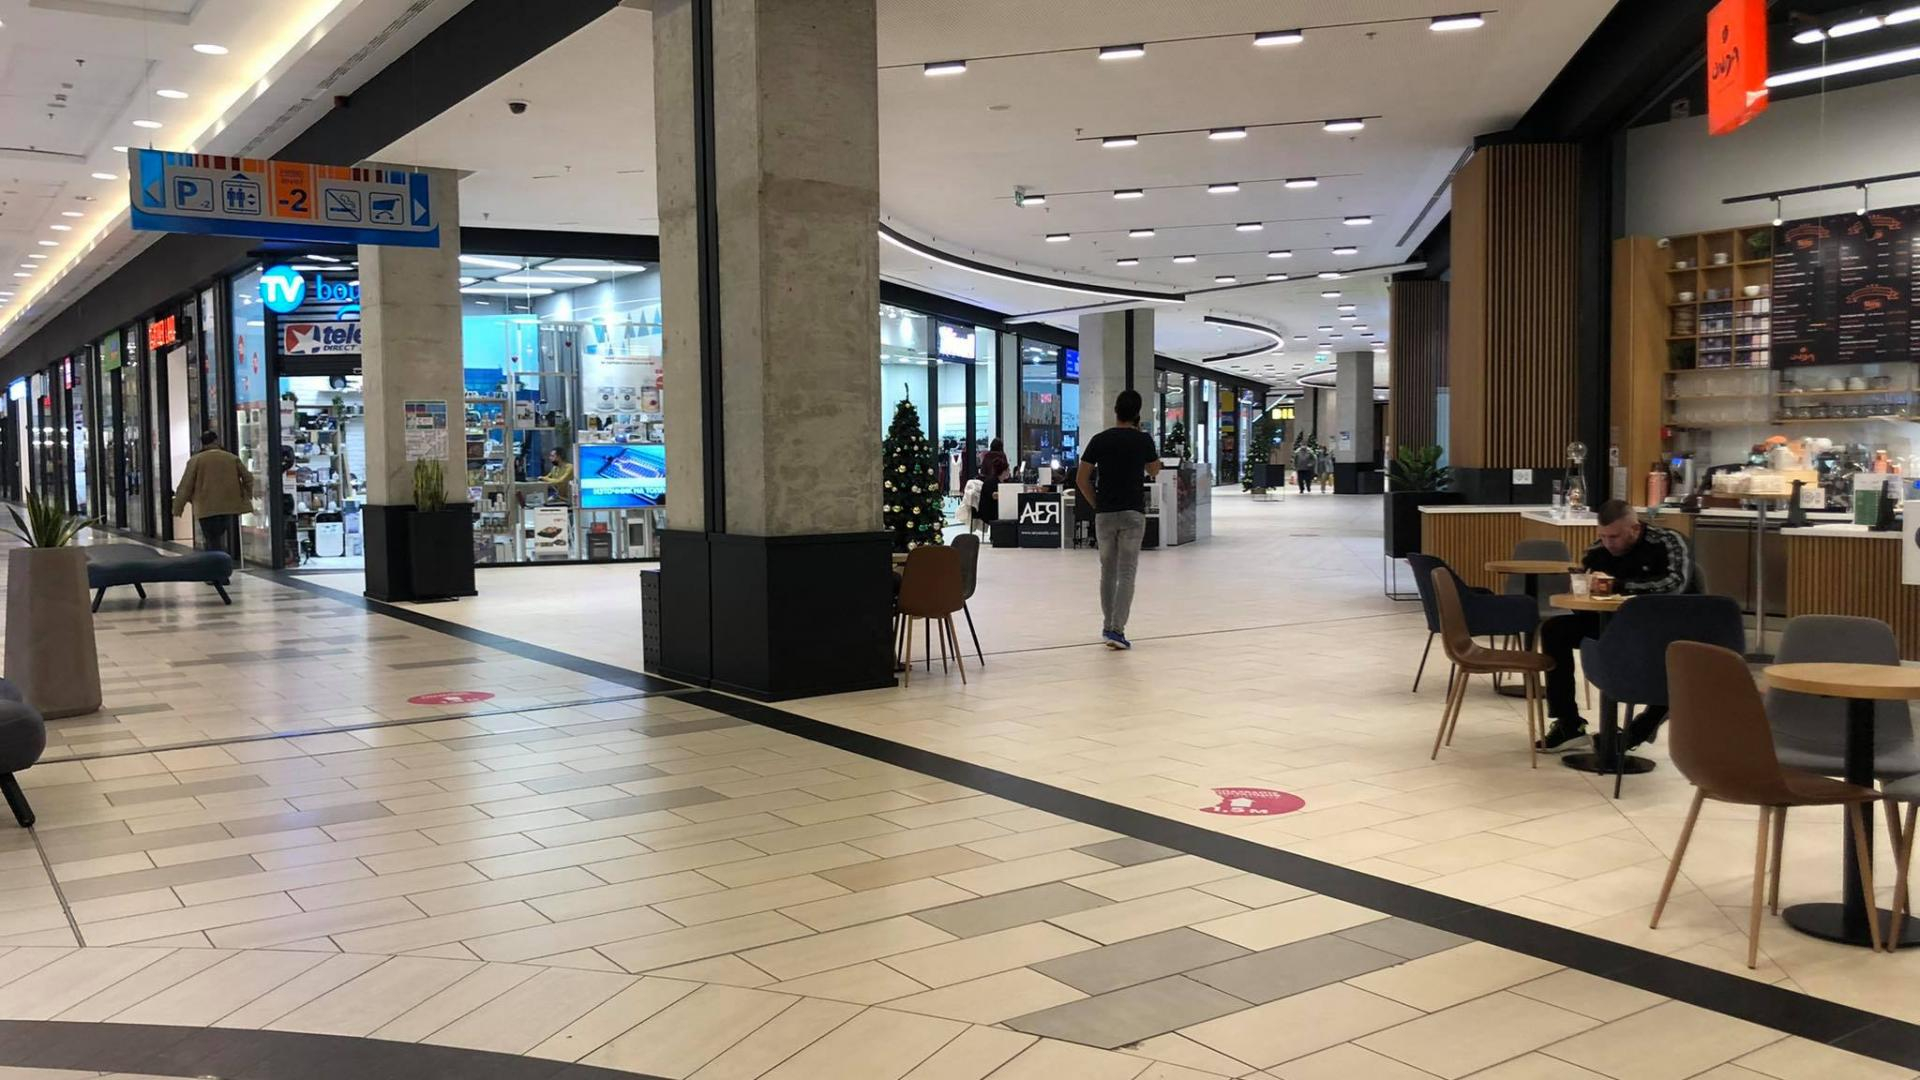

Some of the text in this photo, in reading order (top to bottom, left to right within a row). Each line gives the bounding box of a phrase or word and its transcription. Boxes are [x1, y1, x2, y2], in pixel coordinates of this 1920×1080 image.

[177, 180, 198, 206] P
[278, 188, 309, 213] -2
[259, 275, 305, 303] TV
